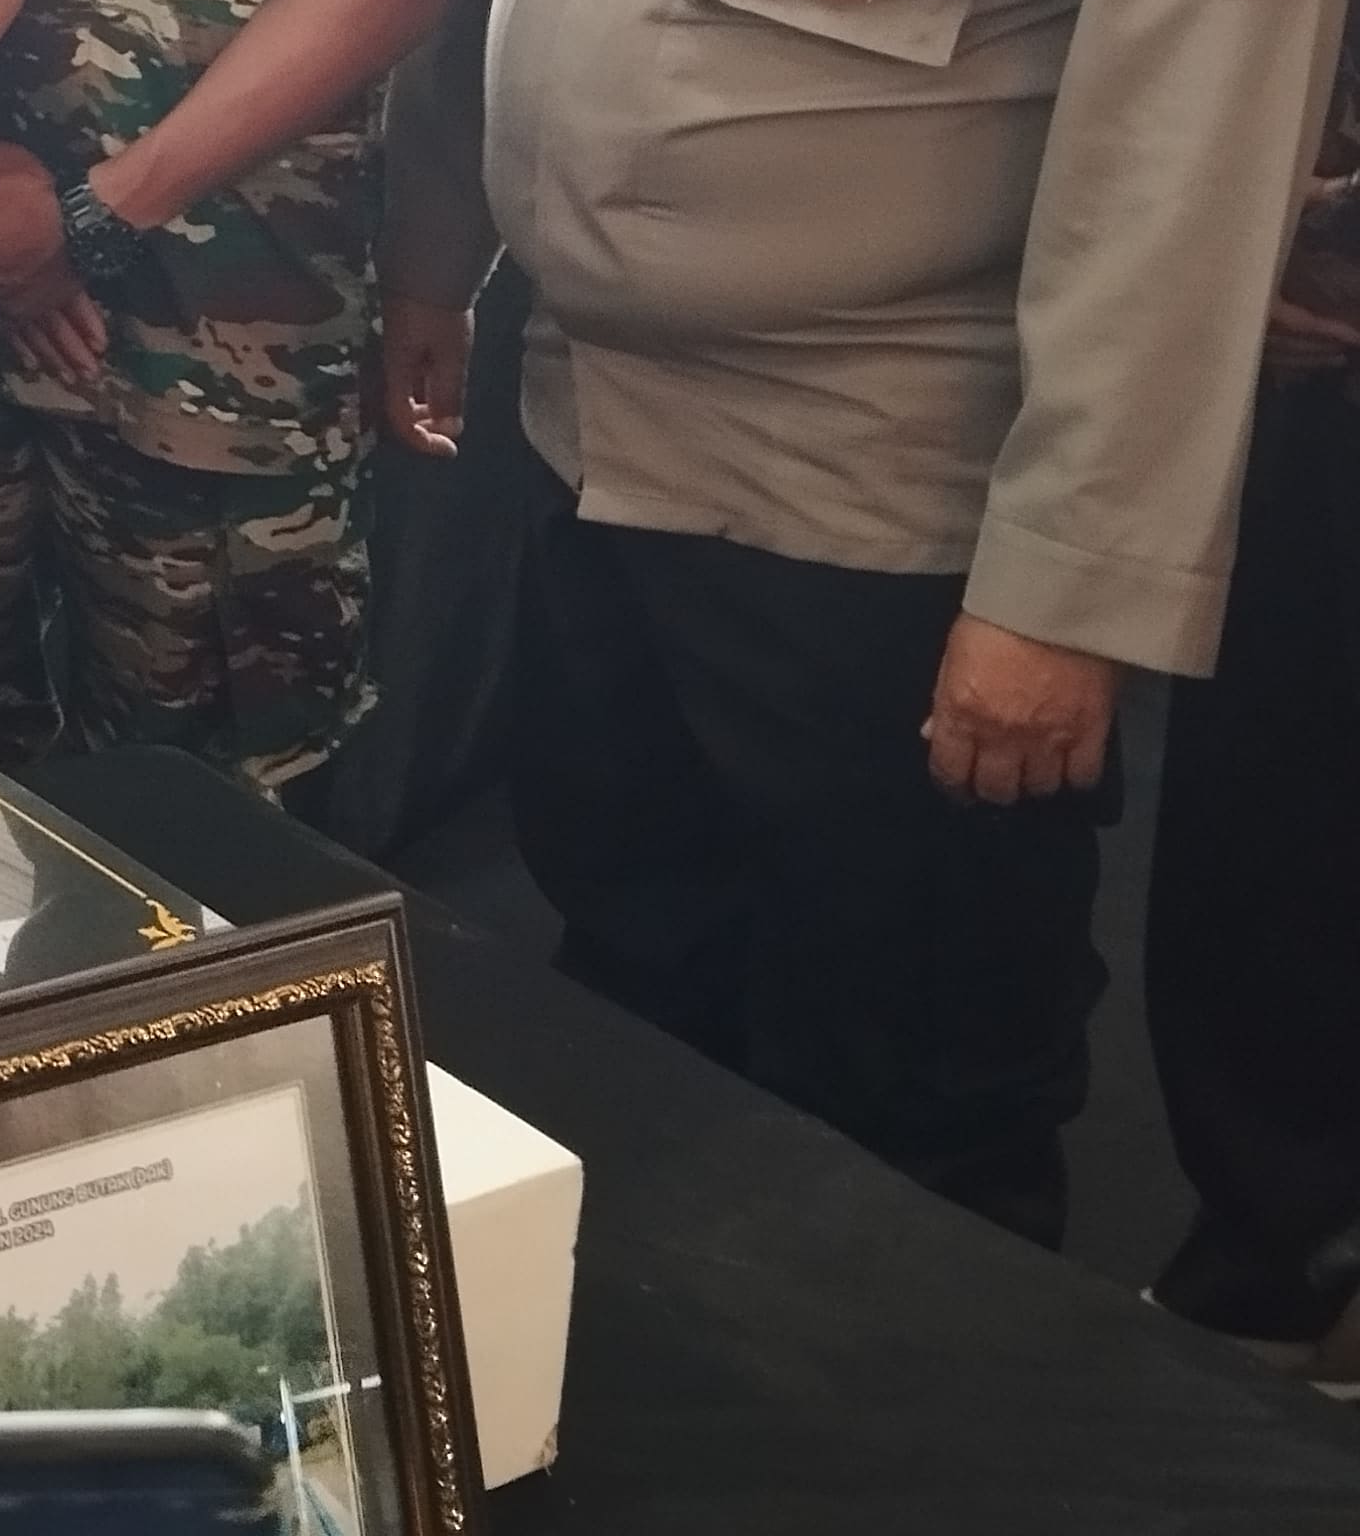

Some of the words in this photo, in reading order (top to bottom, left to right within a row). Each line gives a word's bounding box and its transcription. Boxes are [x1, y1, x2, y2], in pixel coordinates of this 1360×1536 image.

[9, 1186, 77, 1223] GUNUNG
[75, 1172, 133, 1205] BUTAK
[130, 1157, 174, 1191] (DAK)
[12, 1219, 56, 1248] 2024
